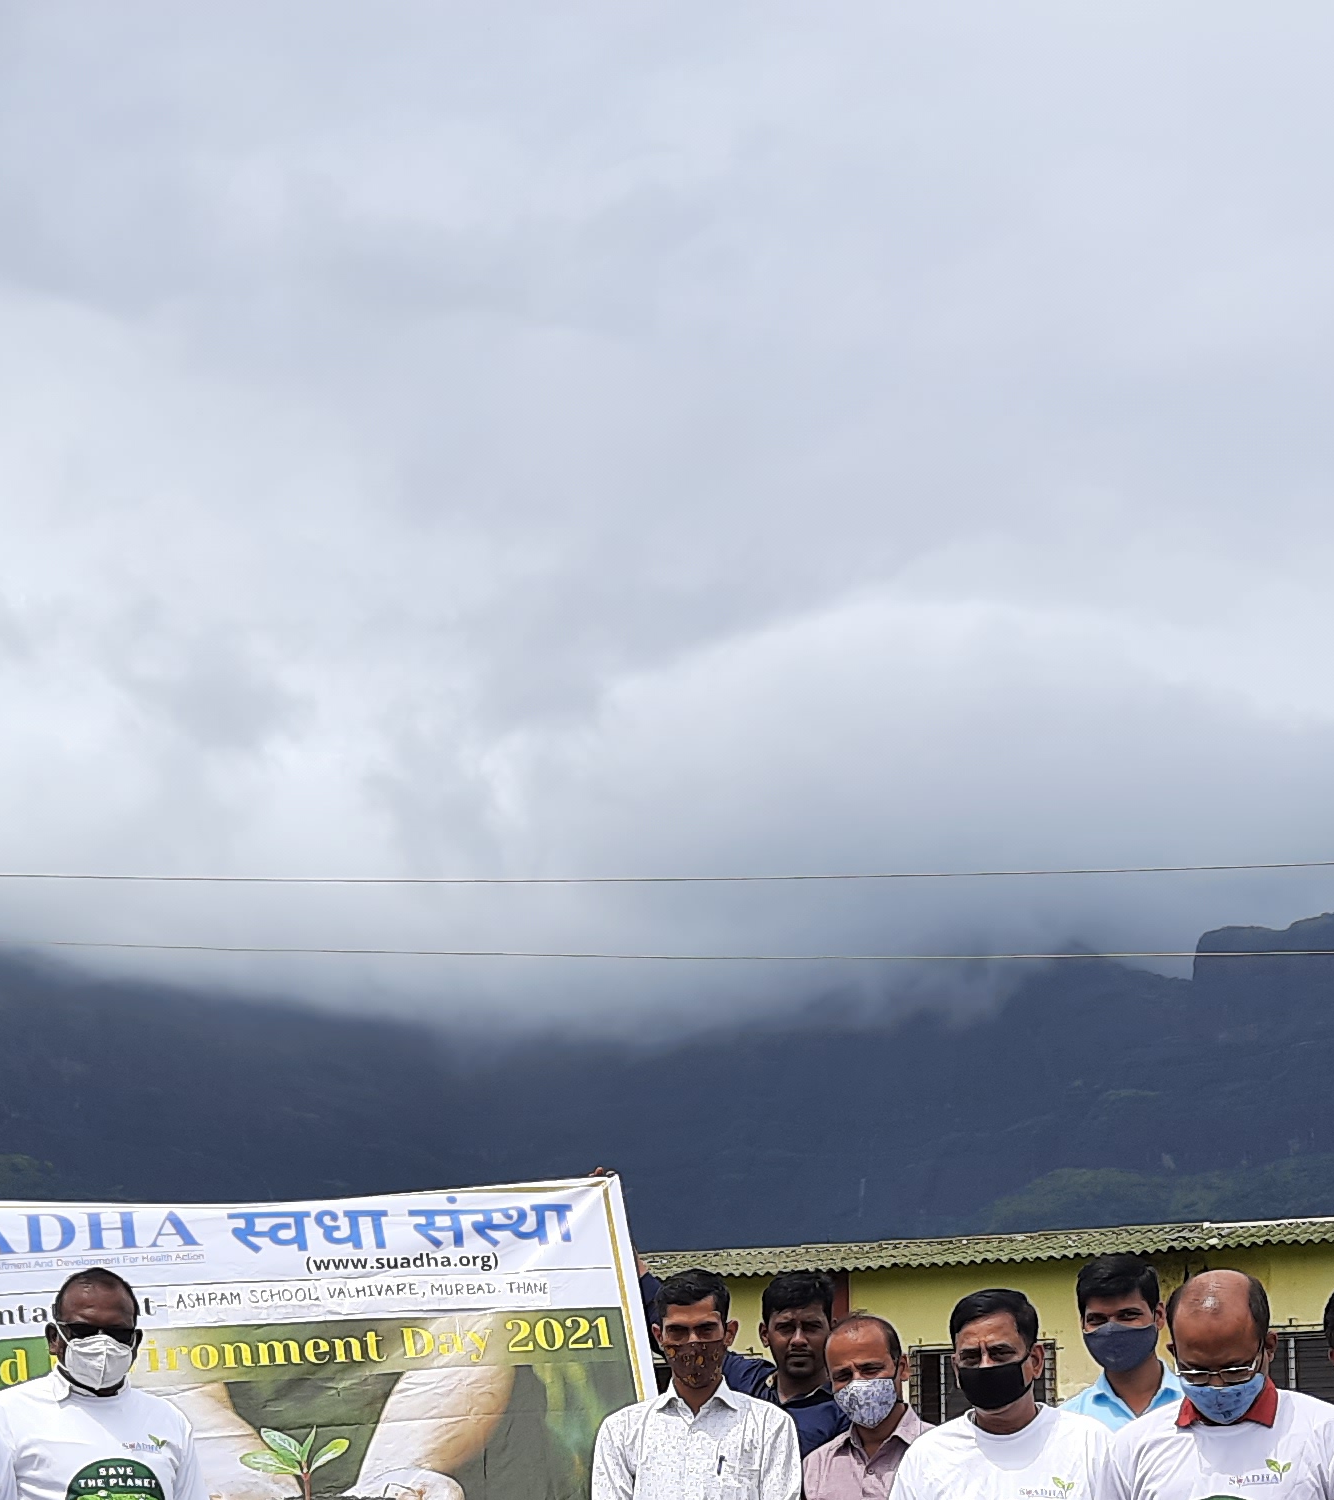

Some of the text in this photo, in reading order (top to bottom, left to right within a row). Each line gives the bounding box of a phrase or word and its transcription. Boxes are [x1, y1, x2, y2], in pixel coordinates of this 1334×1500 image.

[226, 1195, 572, 1254] स्वधा संस्था
[33, 1259, 53, 1268] And
[56, 1256, 120, 1267] Development
[122, 1255, 139, 1264] For
[141, 1253, 172, 1263] Health
[174, 1252, 205, 1262] Action
[305, 1251, 499, 1274] (www.suadha.org)
[176, 1291, 242, 1310] ASHRAM
[326, 1281, 426, 1299] VALHIVARE,
[400, 1326, 494, 1362] Day
[504, 1315, 614, 1353] 2021
[98, 1466, 134, 1476] SAVE
[78, 1479, 105, 1488] THE
